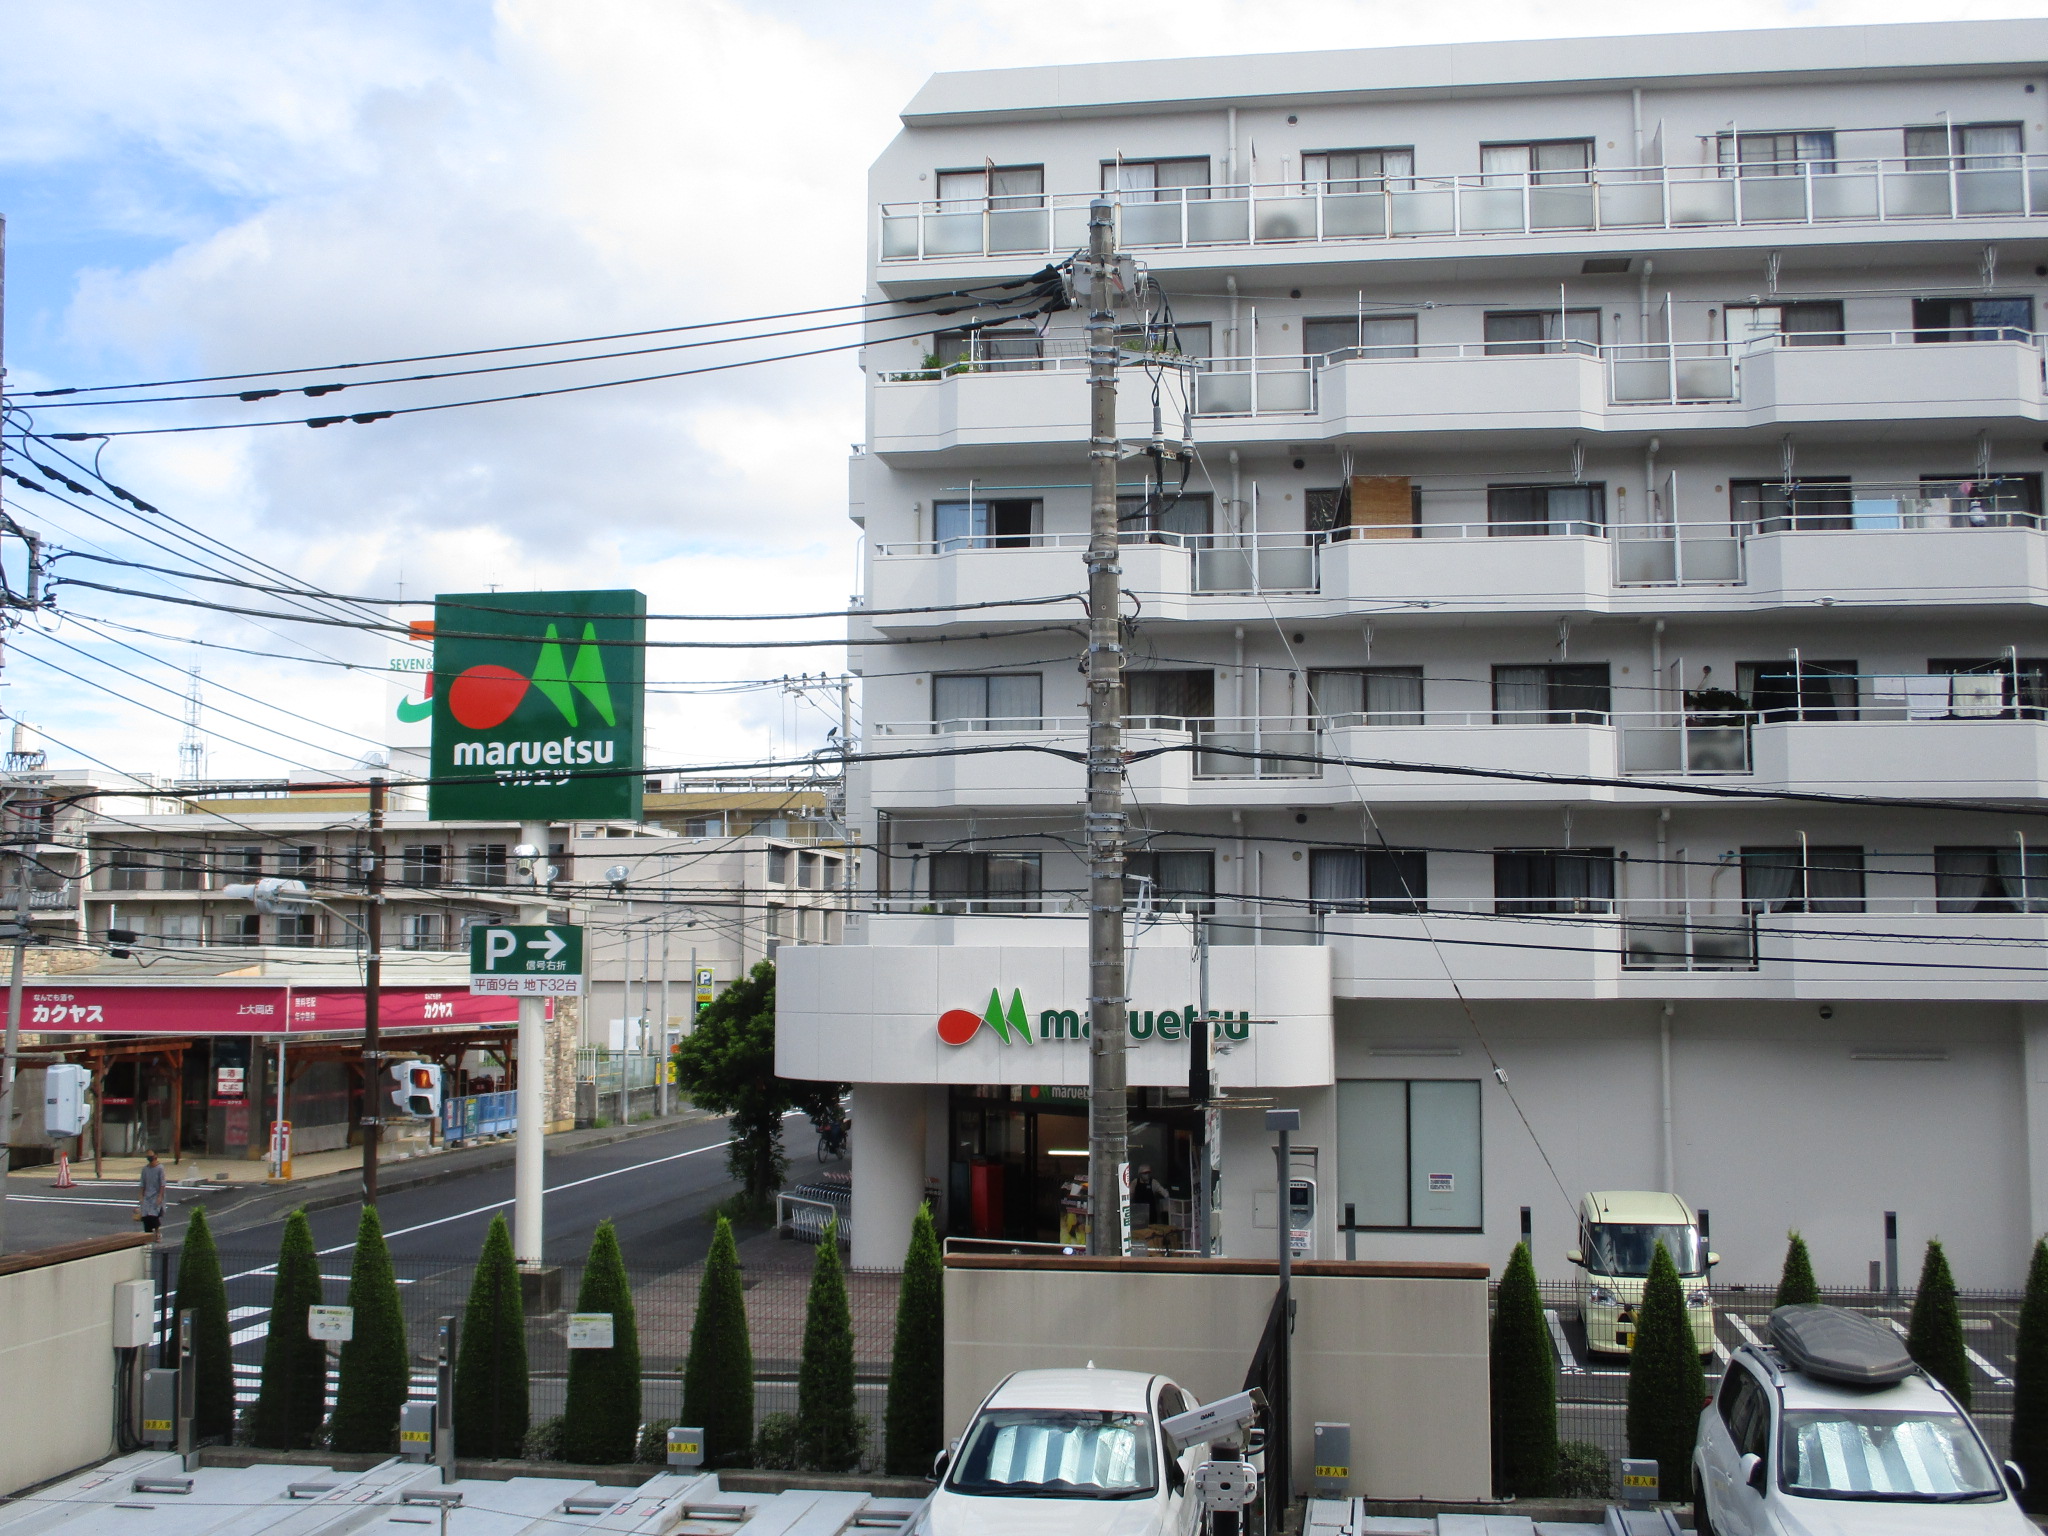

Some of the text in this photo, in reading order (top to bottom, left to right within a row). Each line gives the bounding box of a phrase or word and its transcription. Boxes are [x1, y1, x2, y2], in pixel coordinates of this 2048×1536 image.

[454, 736, 614, 766] maruetsu
[485, 929, 517, 971] P
[526, 960, 567, 971] 信号右折
[475, 978, 577, 992] 平面9台 地下32台
[33, 993, 75, 1002] なんでも酒や
[32, 1004, 104, 1023] カクヤス
[236, 1004, 274, 1015] 上大岡店
[424, 1002, 453, 1019] カクヤス
[1040, 1004, 1250, 1040] muetsu
[1052, 1086, 1091, 1099] maruet
